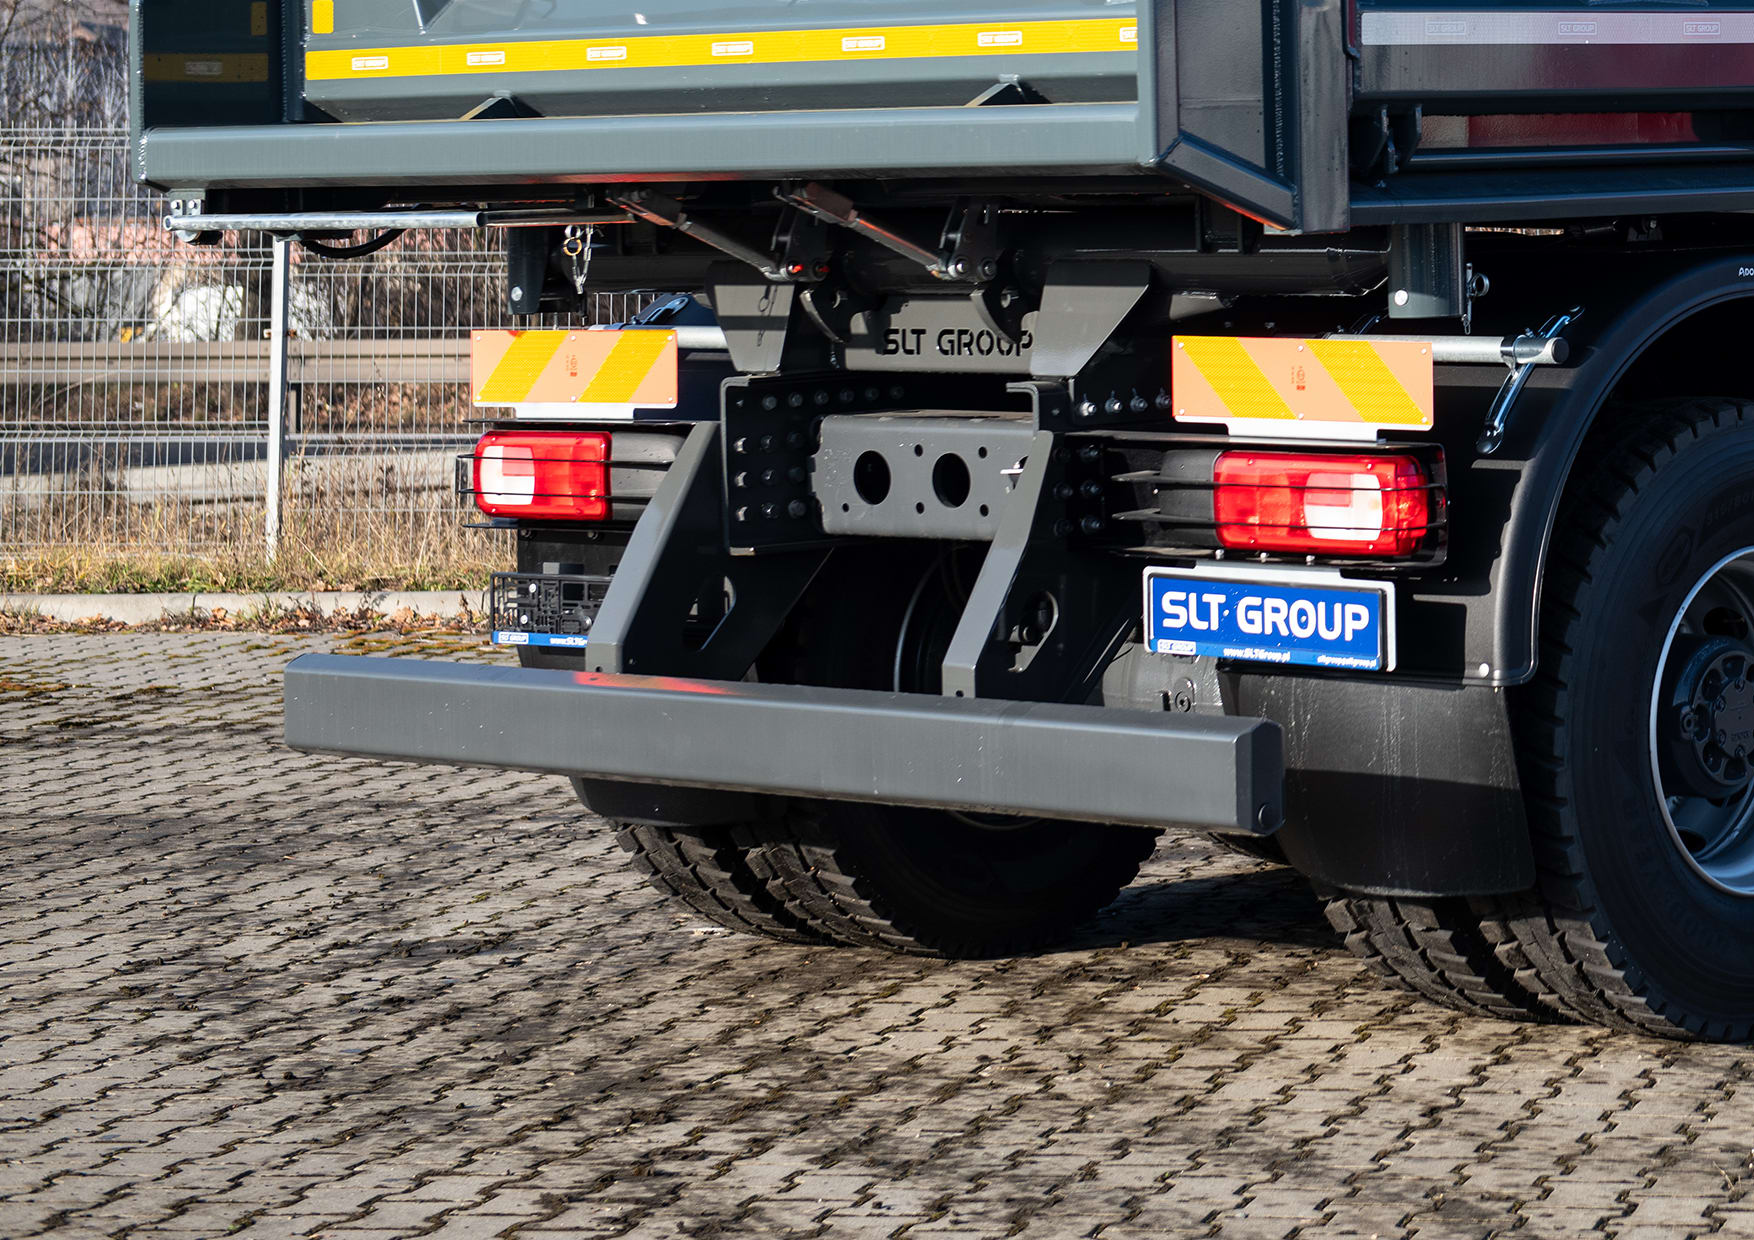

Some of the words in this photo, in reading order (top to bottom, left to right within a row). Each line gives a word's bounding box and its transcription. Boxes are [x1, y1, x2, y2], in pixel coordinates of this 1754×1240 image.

[883, 328, 927, 355] SLT
[937, 328, 1033, 357] GROUP
[1161, 590, 1227, 631] SLT
[1236, 595, 1370, 642] GROUP
